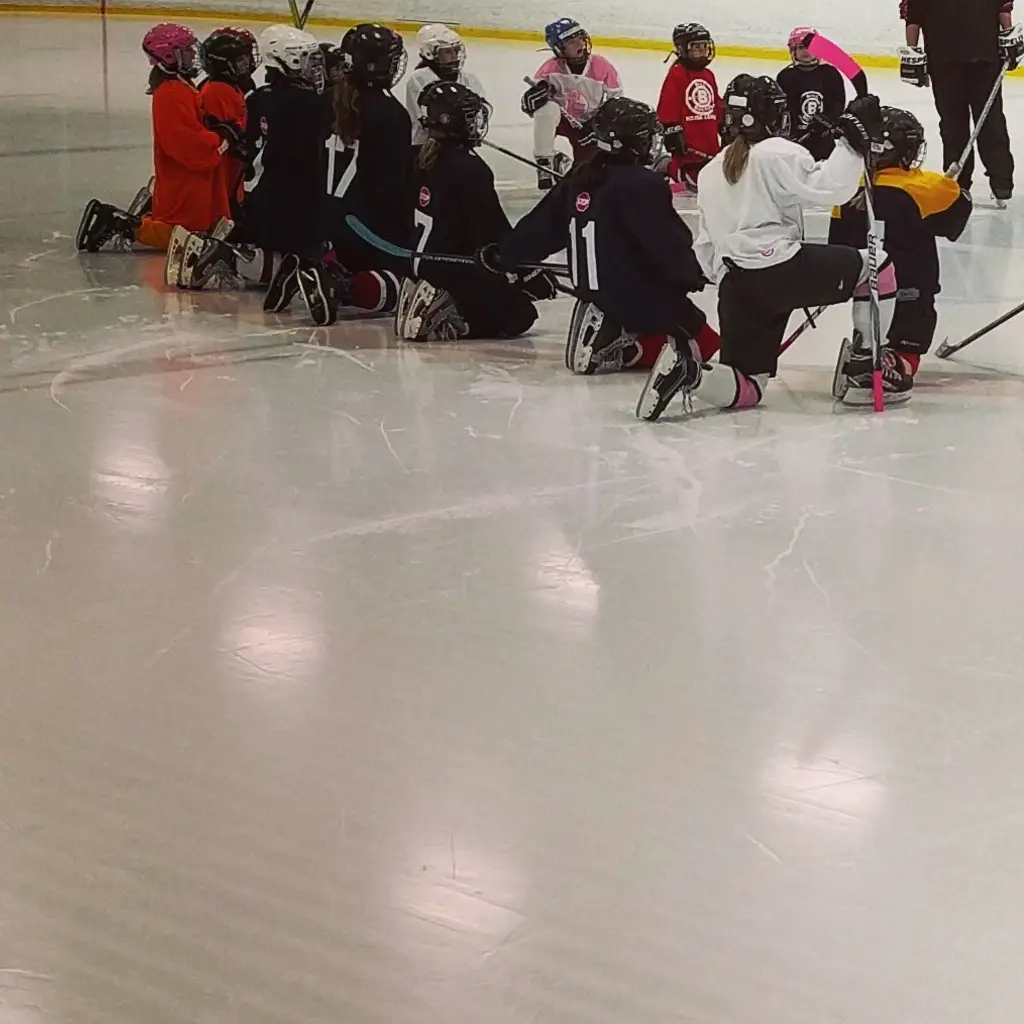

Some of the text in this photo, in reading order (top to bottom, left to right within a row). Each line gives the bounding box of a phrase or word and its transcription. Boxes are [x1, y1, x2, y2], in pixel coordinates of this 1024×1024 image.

[413, 207, 434, 277] 7
[569, 216, 599, 291] 11
[868, 233, 879, 292] BAUER
